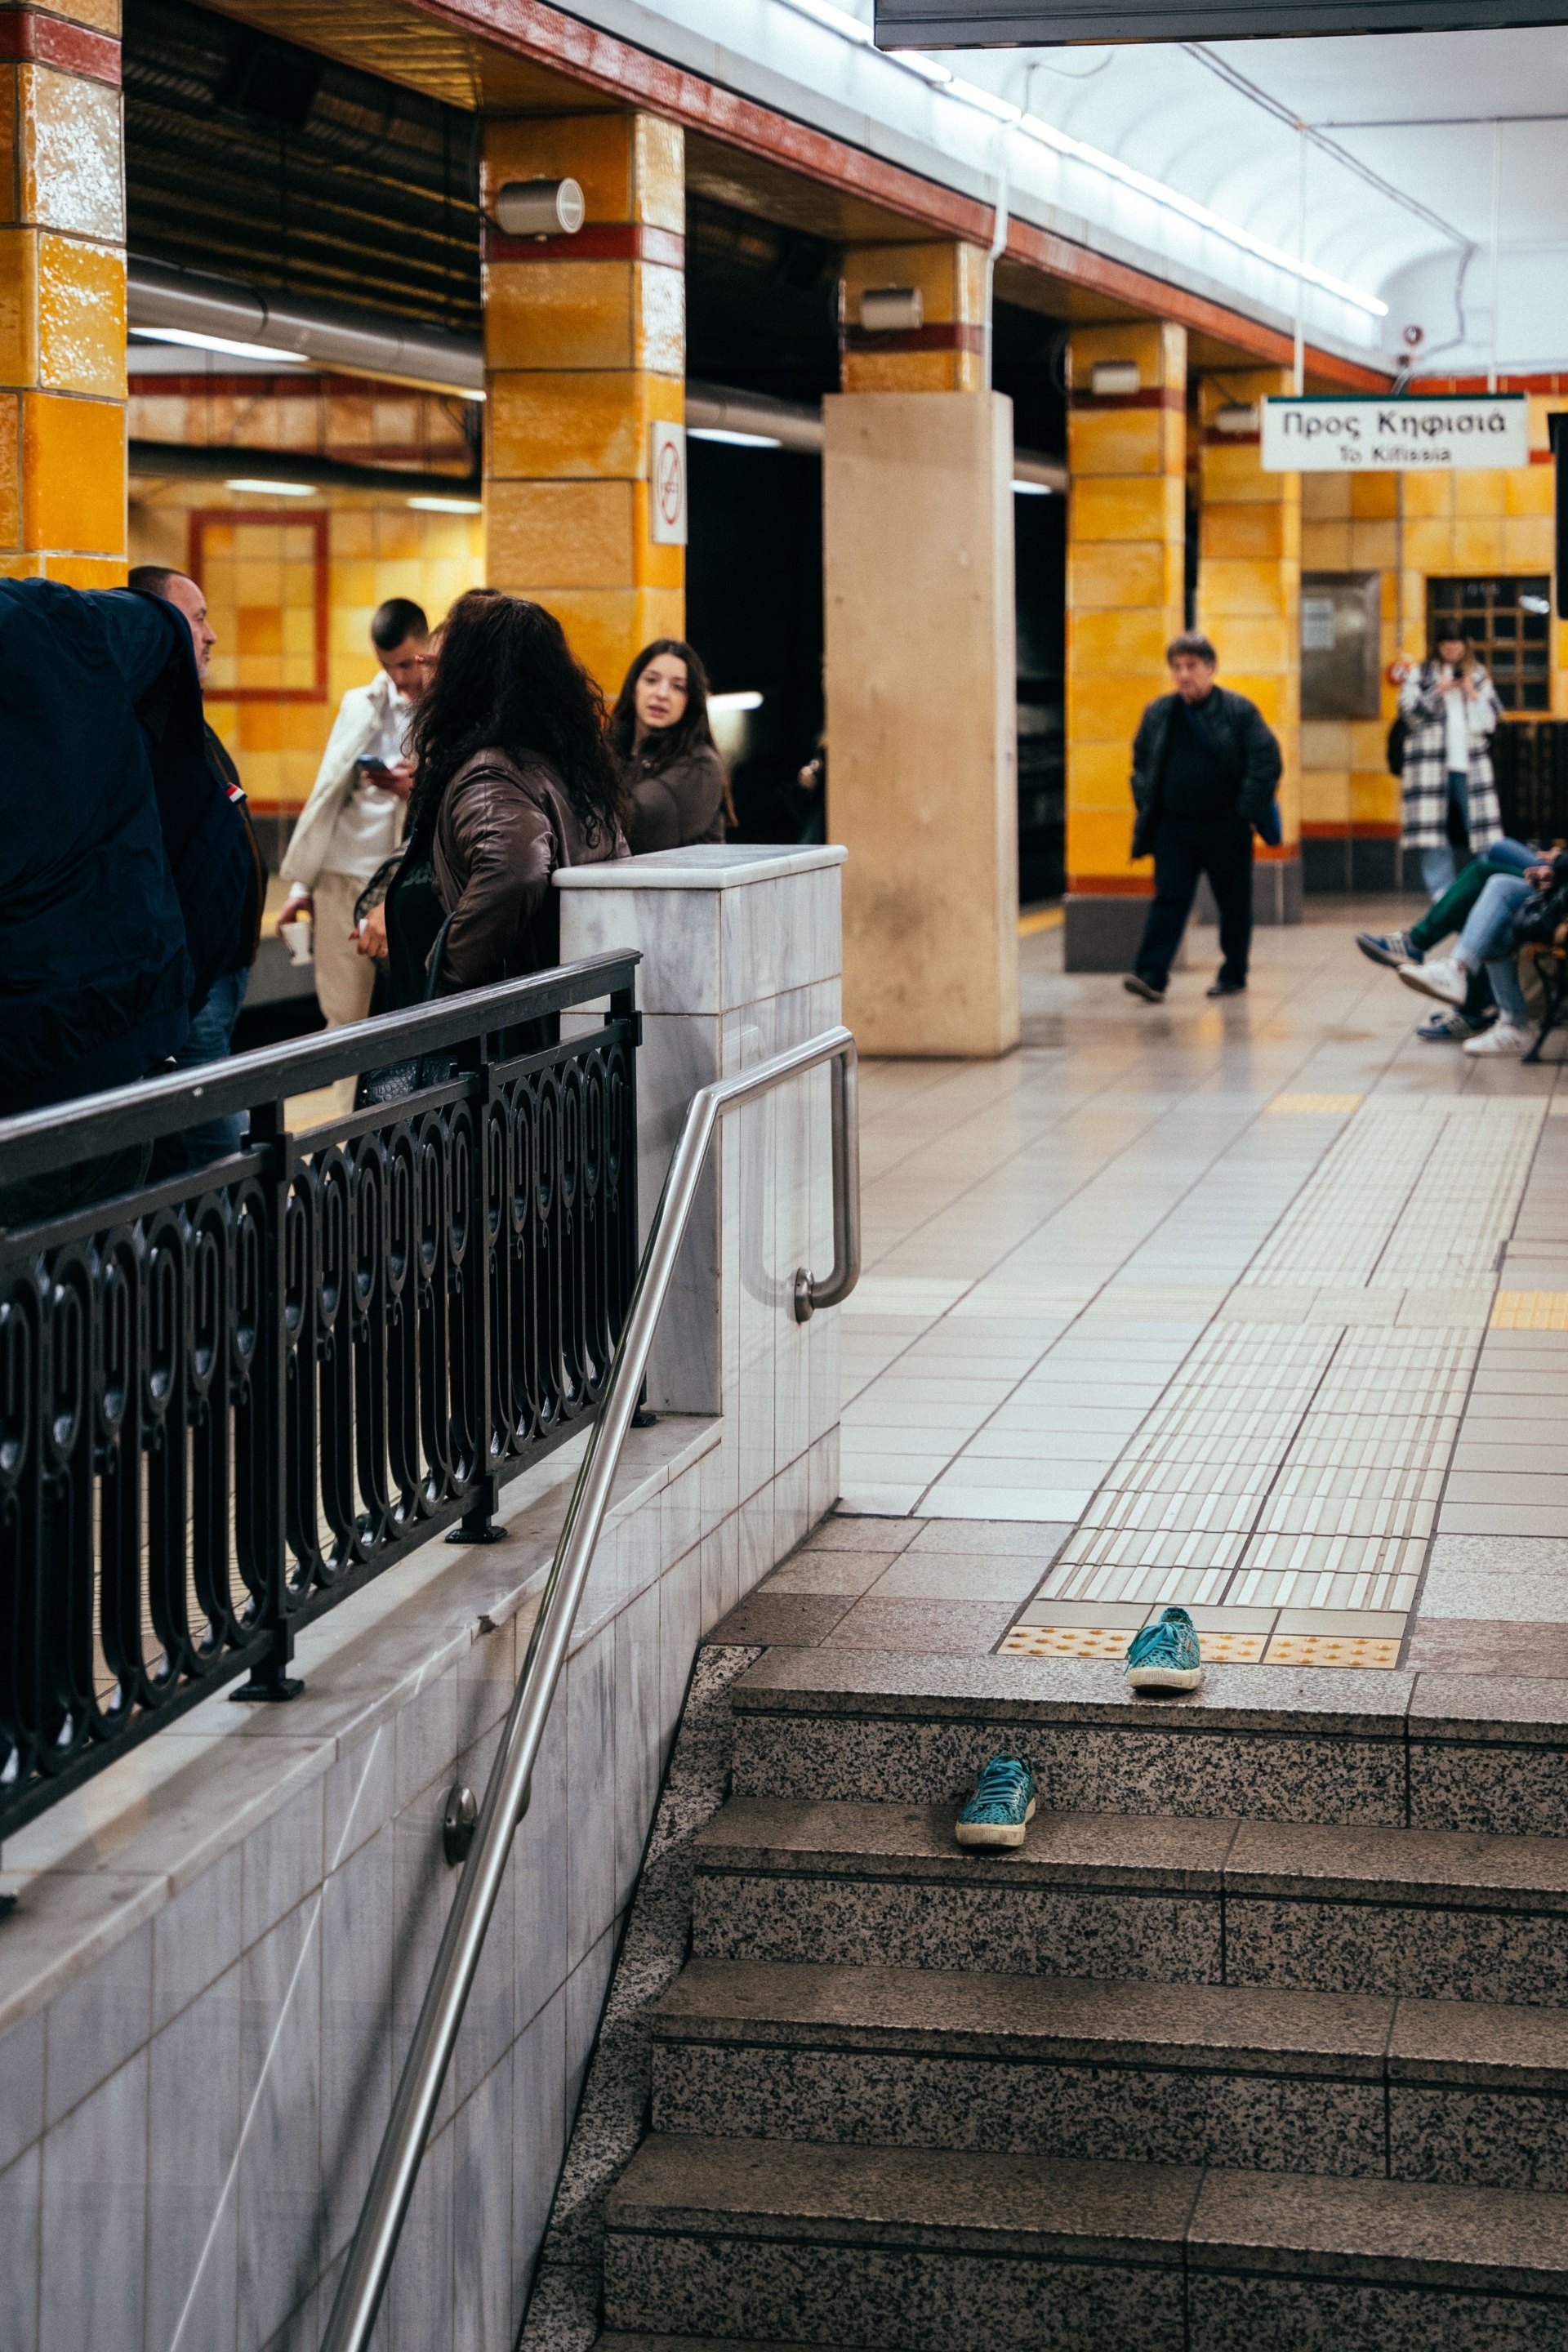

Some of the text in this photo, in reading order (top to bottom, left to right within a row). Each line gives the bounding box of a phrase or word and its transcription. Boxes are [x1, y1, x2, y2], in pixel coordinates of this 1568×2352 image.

[1283, 408, 1506, 439] Προς Κηφισιά
[1339, 445, 1451, 463] To Kifissia
